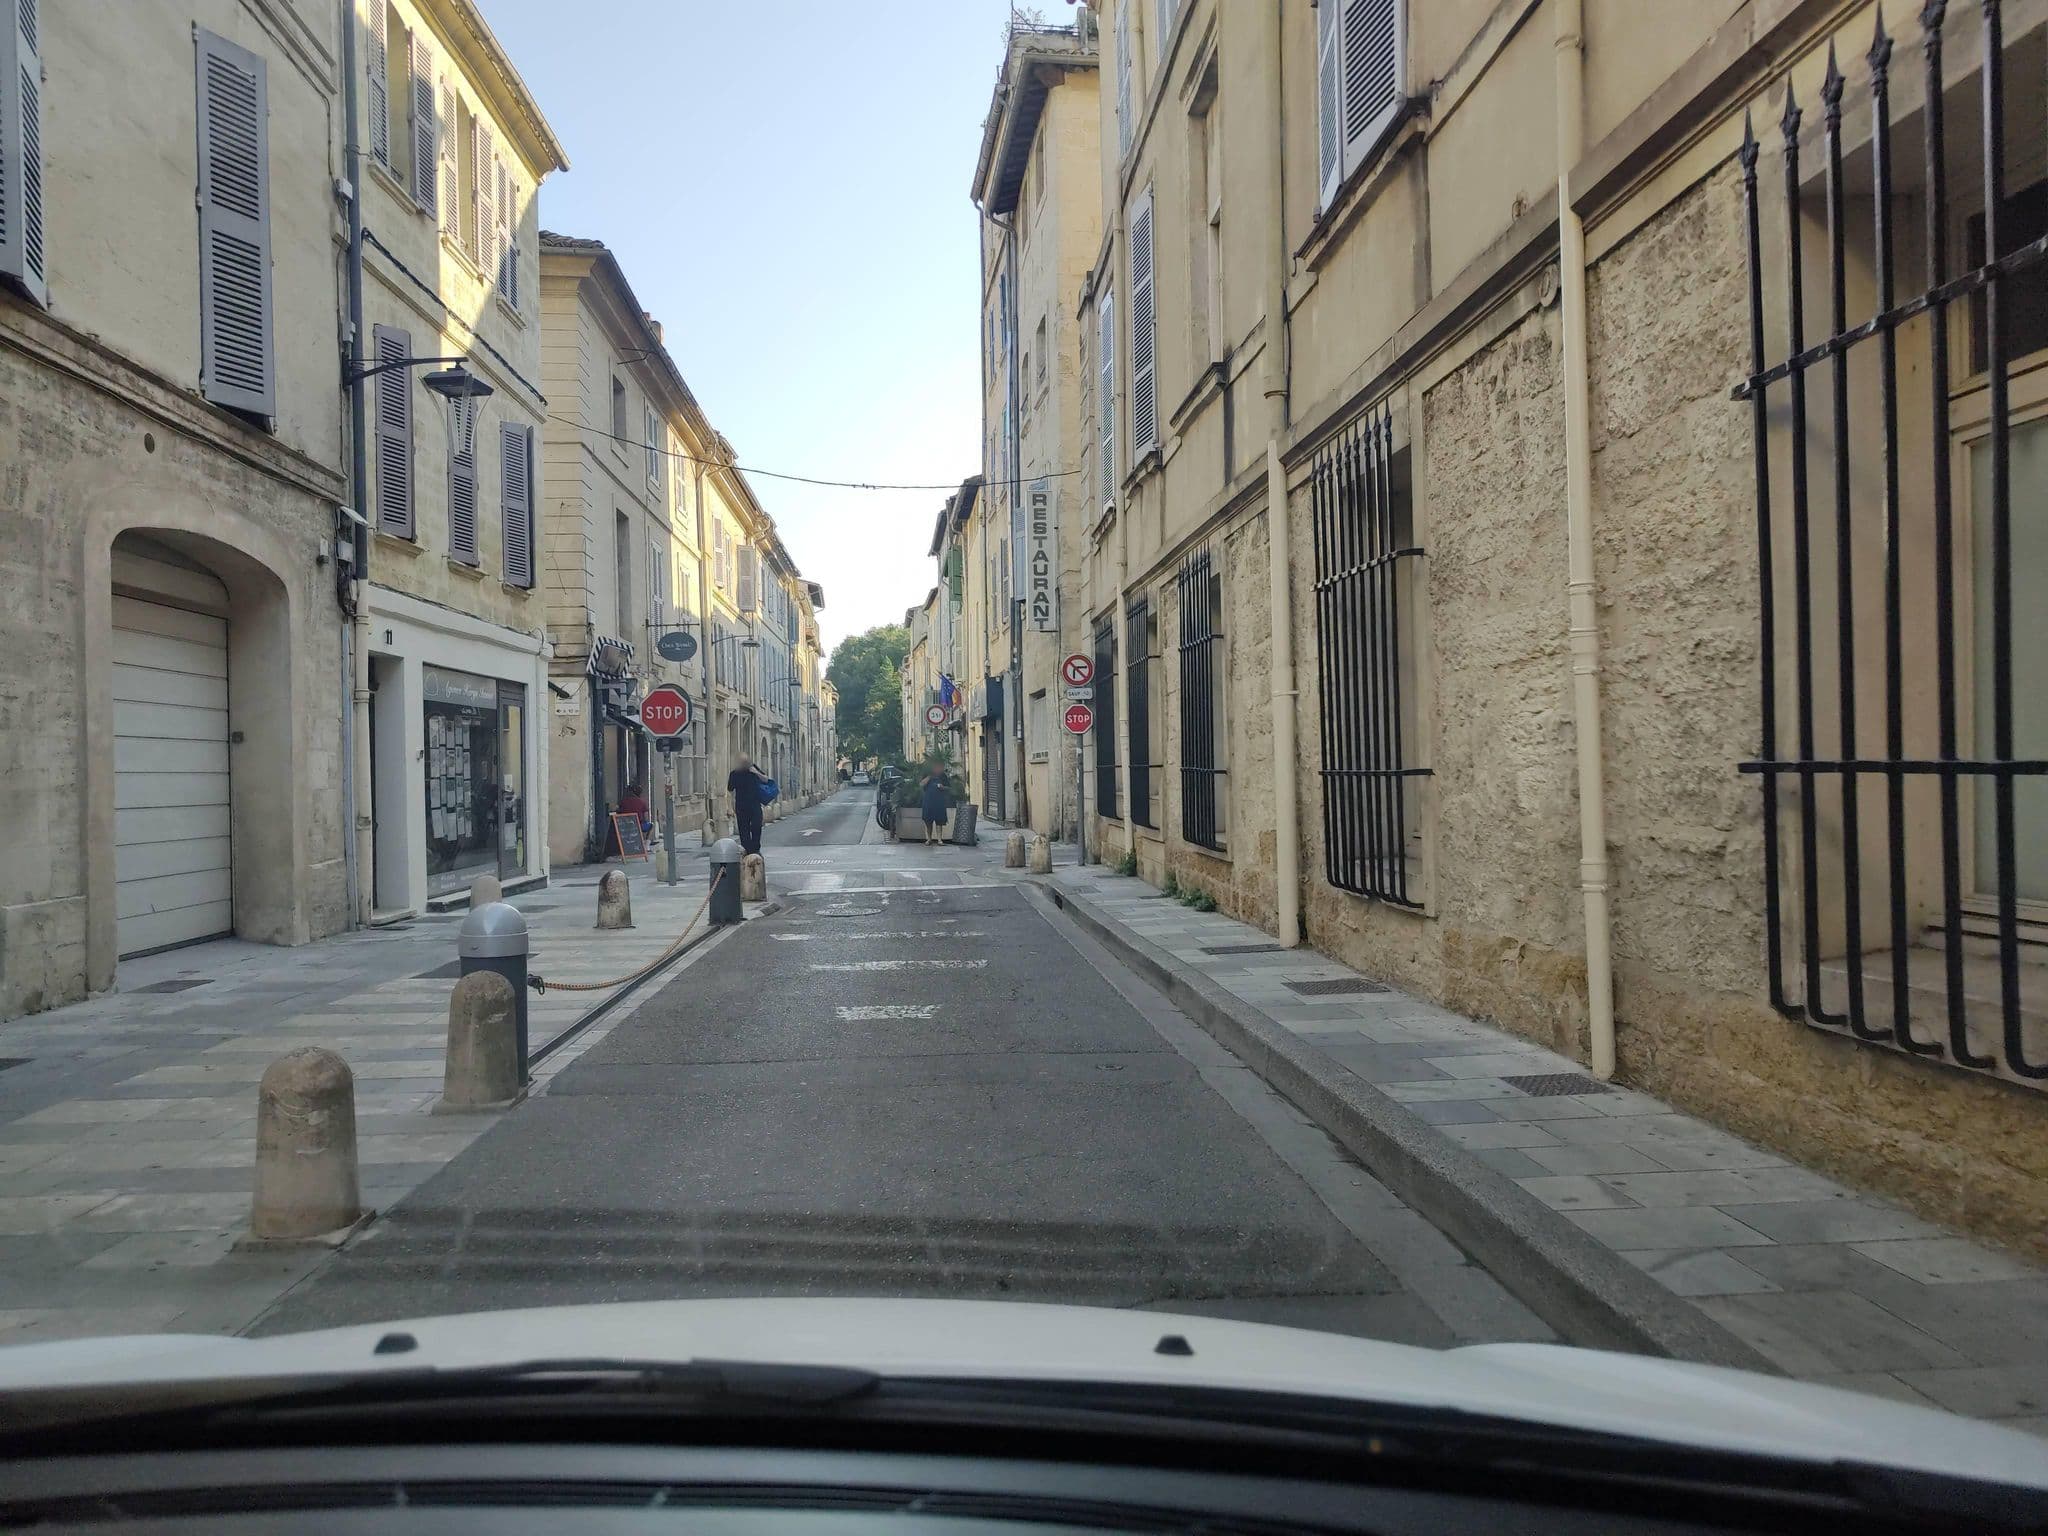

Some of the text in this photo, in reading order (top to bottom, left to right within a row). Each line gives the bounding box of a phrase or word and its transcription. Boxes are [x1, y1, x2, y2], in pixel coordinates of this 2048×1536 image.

[1032, 493, 1049, 630] RESTAURANT
[385, 629, 393, 645] 11
[646, 706, 683, 720] STOP
[1067, 714, 1090, 723] STOP
